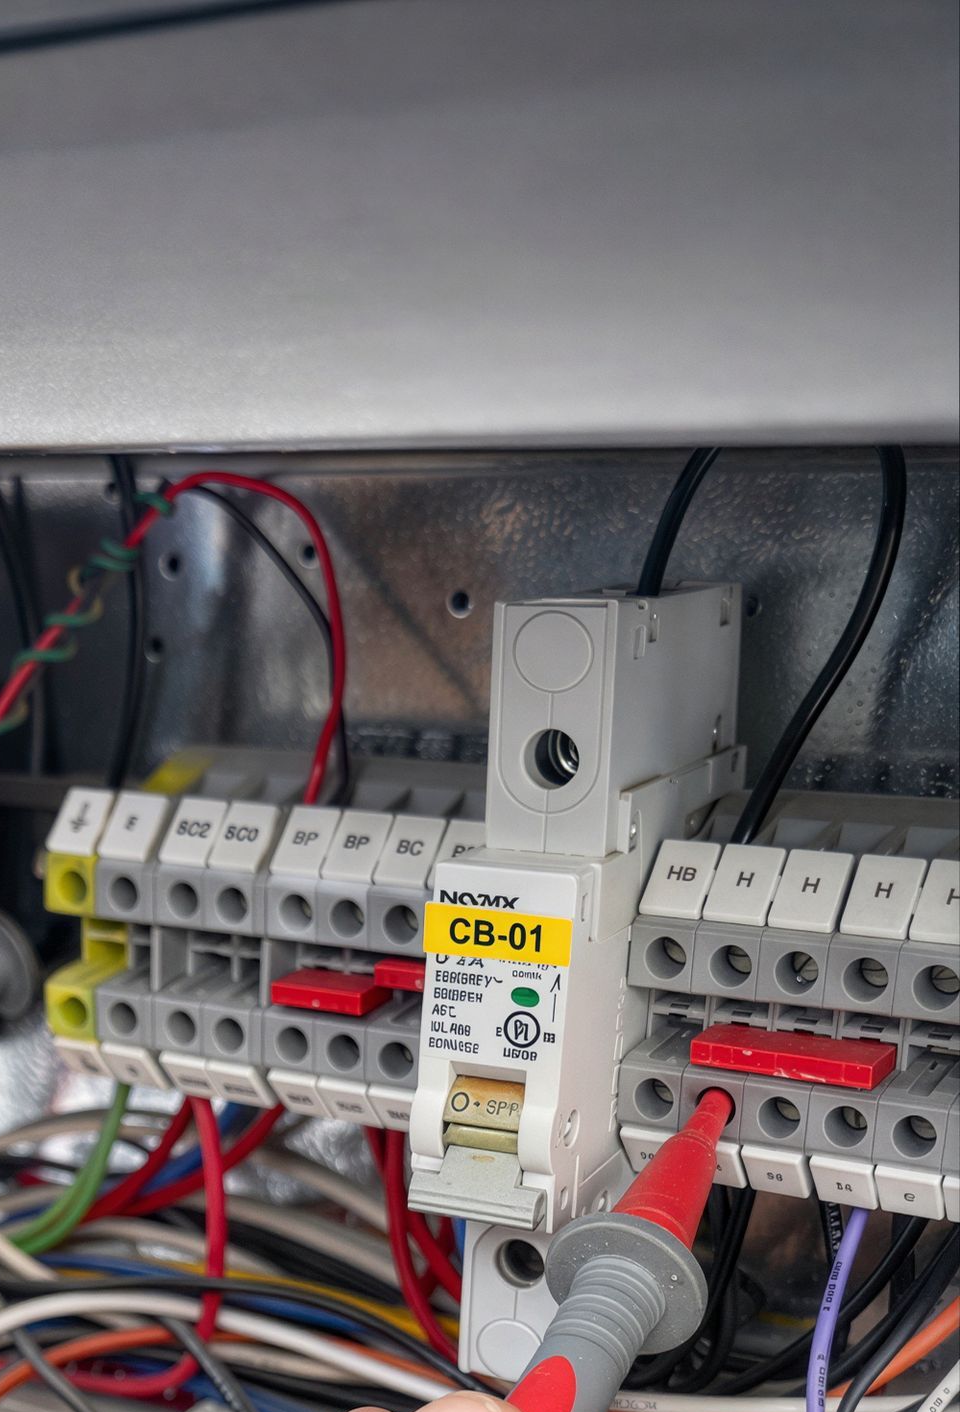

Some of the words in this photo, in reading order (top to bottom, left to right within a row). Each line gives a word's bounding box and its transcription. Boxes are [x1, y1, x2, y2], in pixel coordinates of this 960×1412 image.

[292, 831, 319, 846] BP
[343, 835, 370, 850] BP
[396, 839, 424, 857] BC
[666, 865, 697, 882] HB
[736, 872, 755, 888] H
[801, 877, 821, 893] H
[874, 882, 894, 899] H
[449, 917, 542, 952] CB-01
